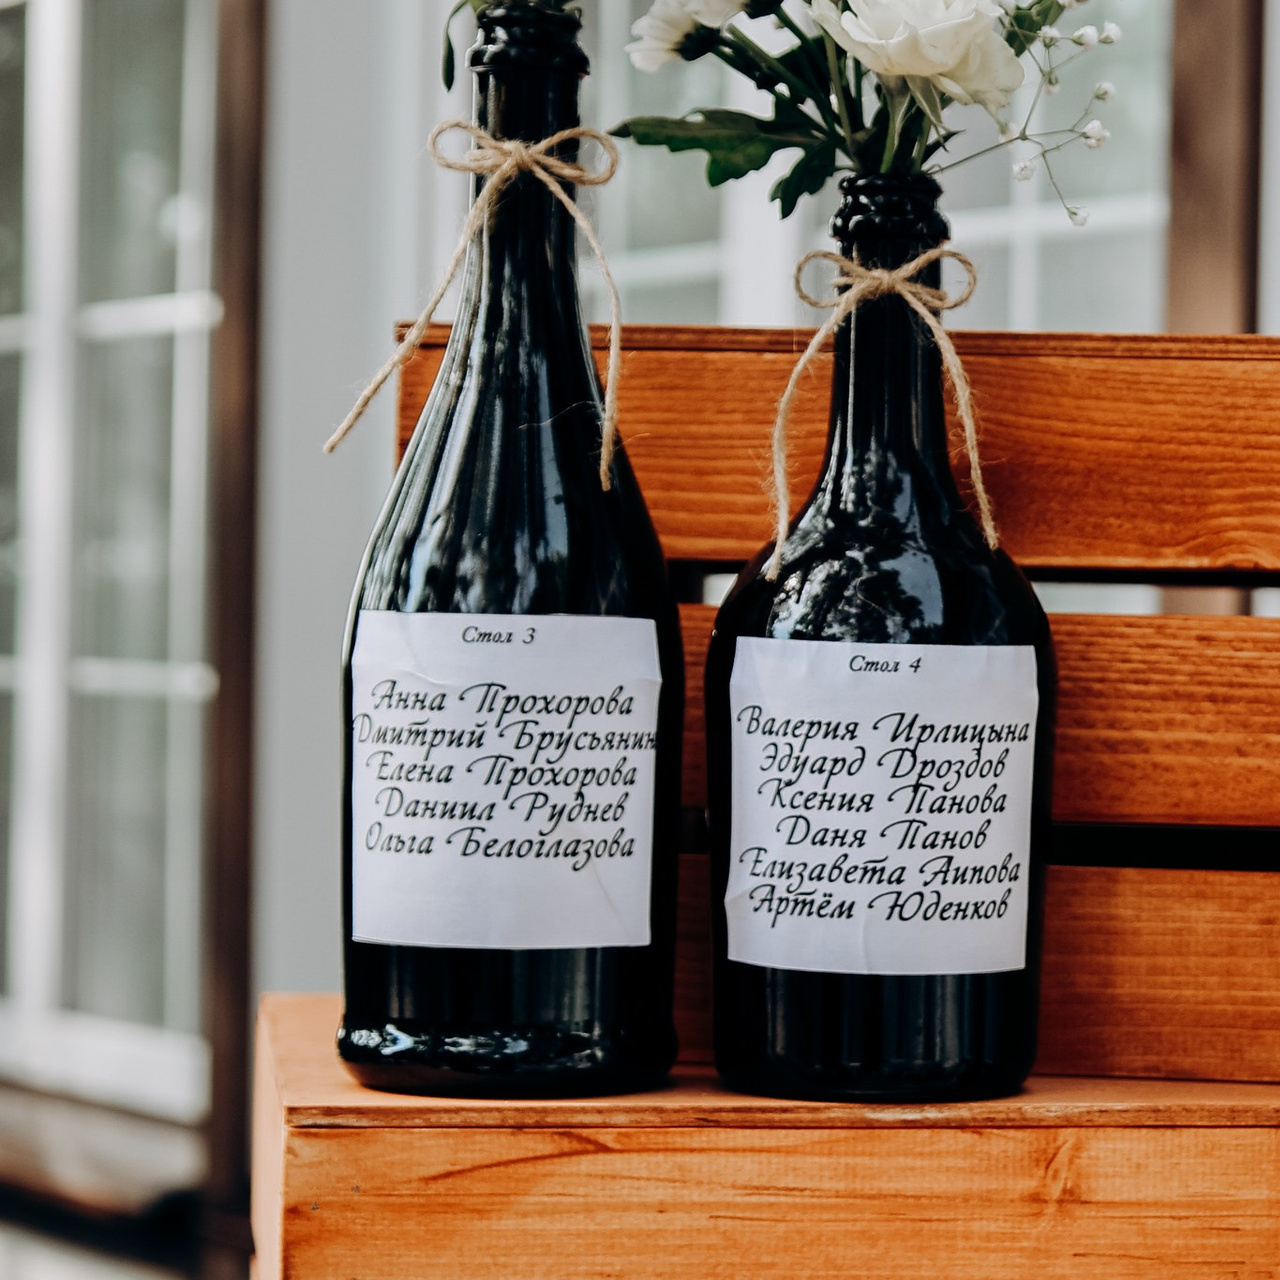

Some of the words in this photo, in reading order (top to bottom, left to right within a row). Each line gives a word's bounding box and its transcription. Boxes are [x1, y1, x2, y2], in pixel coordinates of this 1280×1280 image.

[462, 626, 512, 643] Стол
[522, 627, 535, 644] 3
[849, 655, 899, 672] Стол
[909, 657, 921, 672] 4
[371, 680, 446, 711] Анна
[459, 681, 634, 729] Прохорова
[353, 714, 487, 760] Дмитрий
[737, 705, 858, 752] Валерия
[873, 712, 1029, 753] Ирлицына
[366, 750, 453, 783] Елена
[466, 755, 636, 800] Прохорова
[760, 742, 866, 789] Эдуард
[877, 747, 1009, 792] Дроздов
[375, 787, 496, 821] Даниил
[509, 791, 629, 836] Руднев
[758, 778, 874, 812] Ксения
[888, 783, 1008, 814] Панова
[365, 822, 434, 855] Ольга
[445, 826, 635, 871] Белоглазова
[776, 815, 867, 848] Даня
[880, 818, 991, 850] Панов
[739, 847, 906, 893] Елизавета
[919, 852, 1021, 887] Аипова
[749, 884, 855, 928] Артём
[867, 888, 1012, 922] Юденков
